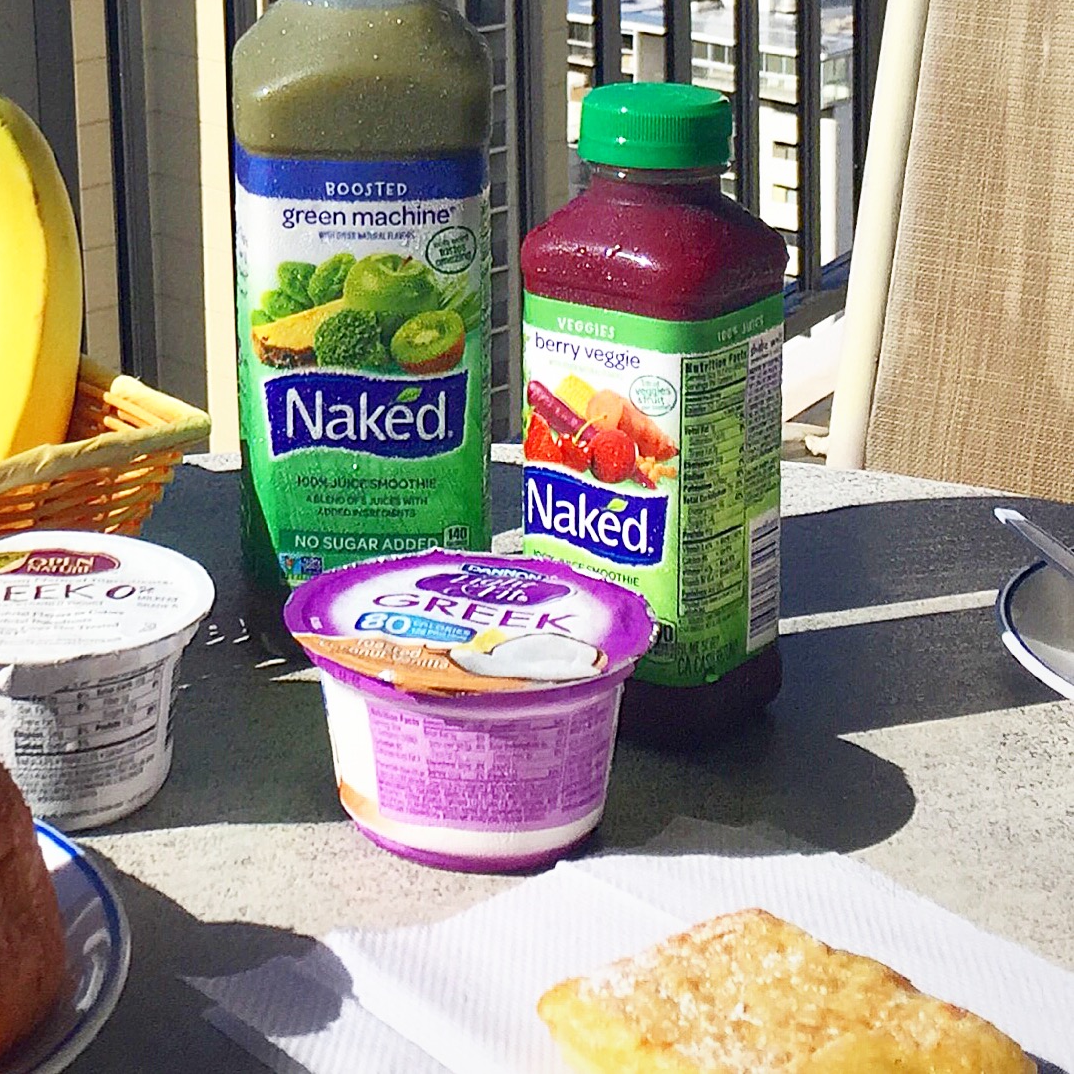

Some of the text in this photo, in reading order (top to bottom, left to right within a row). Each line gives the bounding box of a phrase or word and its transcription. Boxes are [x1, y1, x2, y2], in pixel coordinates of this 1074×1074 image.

[325, 181, 408, 197] BOOSTED
[282, 205, 451, 229] green machine
[557, 316, 616, 340] VEGGIES
[534, 331, 579, 361] berry
[584, 345, 641, 371] veggie
[369, 477, 437, 490] SMOOTHIE
[294, 534, 320, 549] NO
[322, 536, 379, 551] SUGAR
[382, 537, 439, 551] ADDED
[447, 527, 468, 540] 140
[360, 612, 412, 635] 80
[372, 592, 579, 634] GREEK
